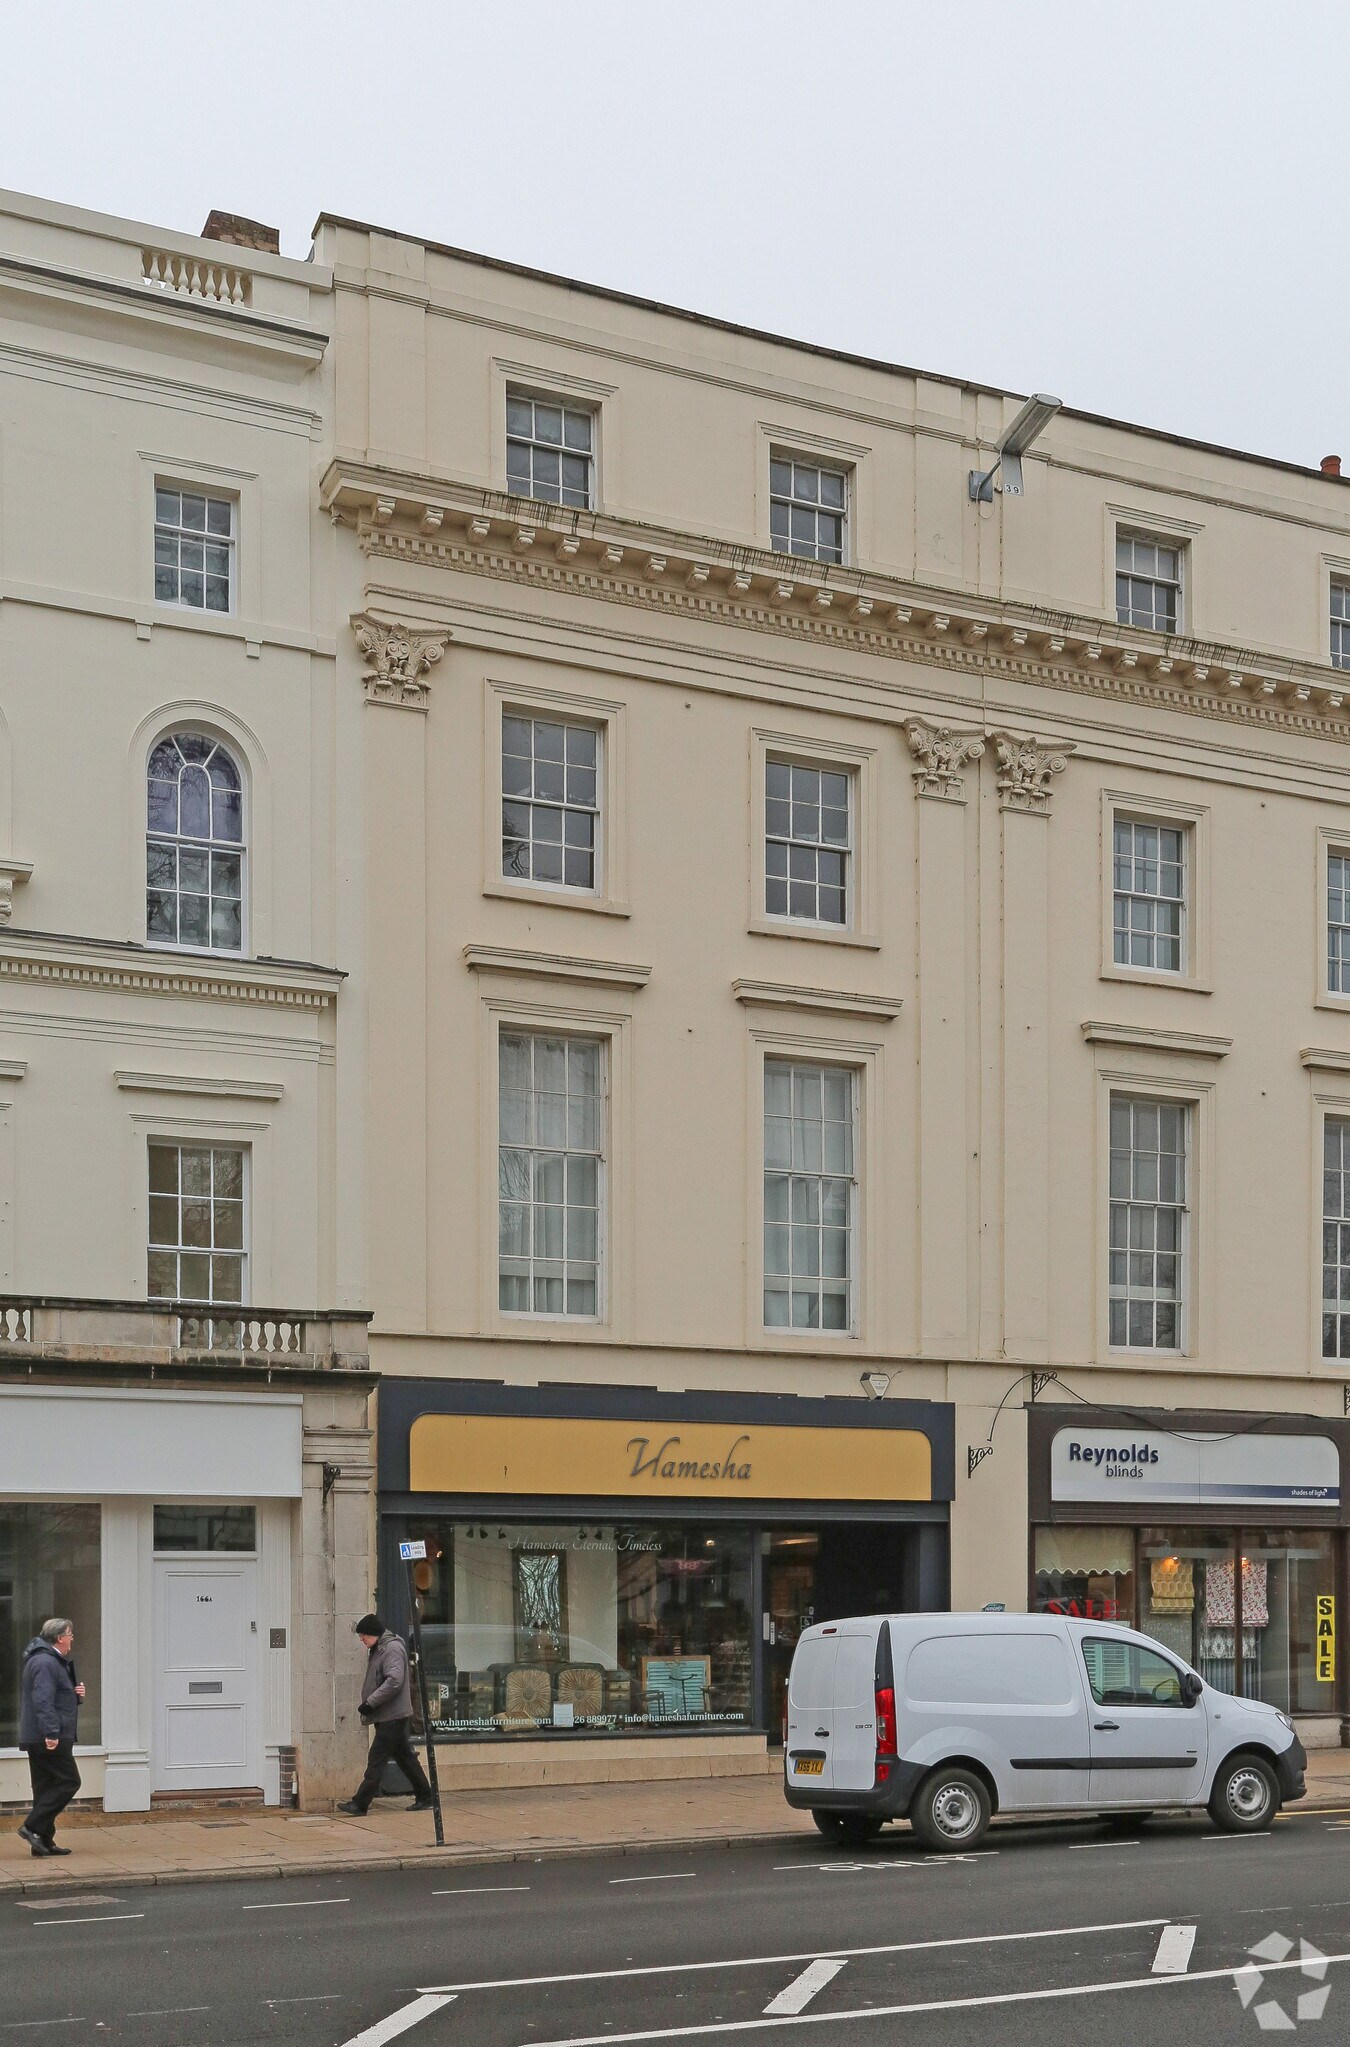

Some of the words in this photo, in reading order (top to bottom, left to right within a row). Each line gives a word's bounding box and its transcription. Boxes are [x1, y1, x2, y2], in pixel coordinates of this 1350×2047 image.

[1005, 484, 1020, 494] 39
[626, 1434, 752, 1479] Hamesha
[1069, 1442, 1159, 1467] Reynolds
[1106, 1464, 1144, 1478] blinds
[1315, 1489, 1326, 1498] light
[508, 1536, 568, 1550] Hamesha:
[617, 1533, 662, 1551] Timeless
[1048, 1599, 1121, 1619] SALE
[1318, 1597, 1334, 1677] SALE
[431, 1716, 552, 1727] ww.hameshafurniture.com
[586, 1714, 617, 1723] 889977
[624, 1711, 744, 1723] info@hameshafurniture.com
